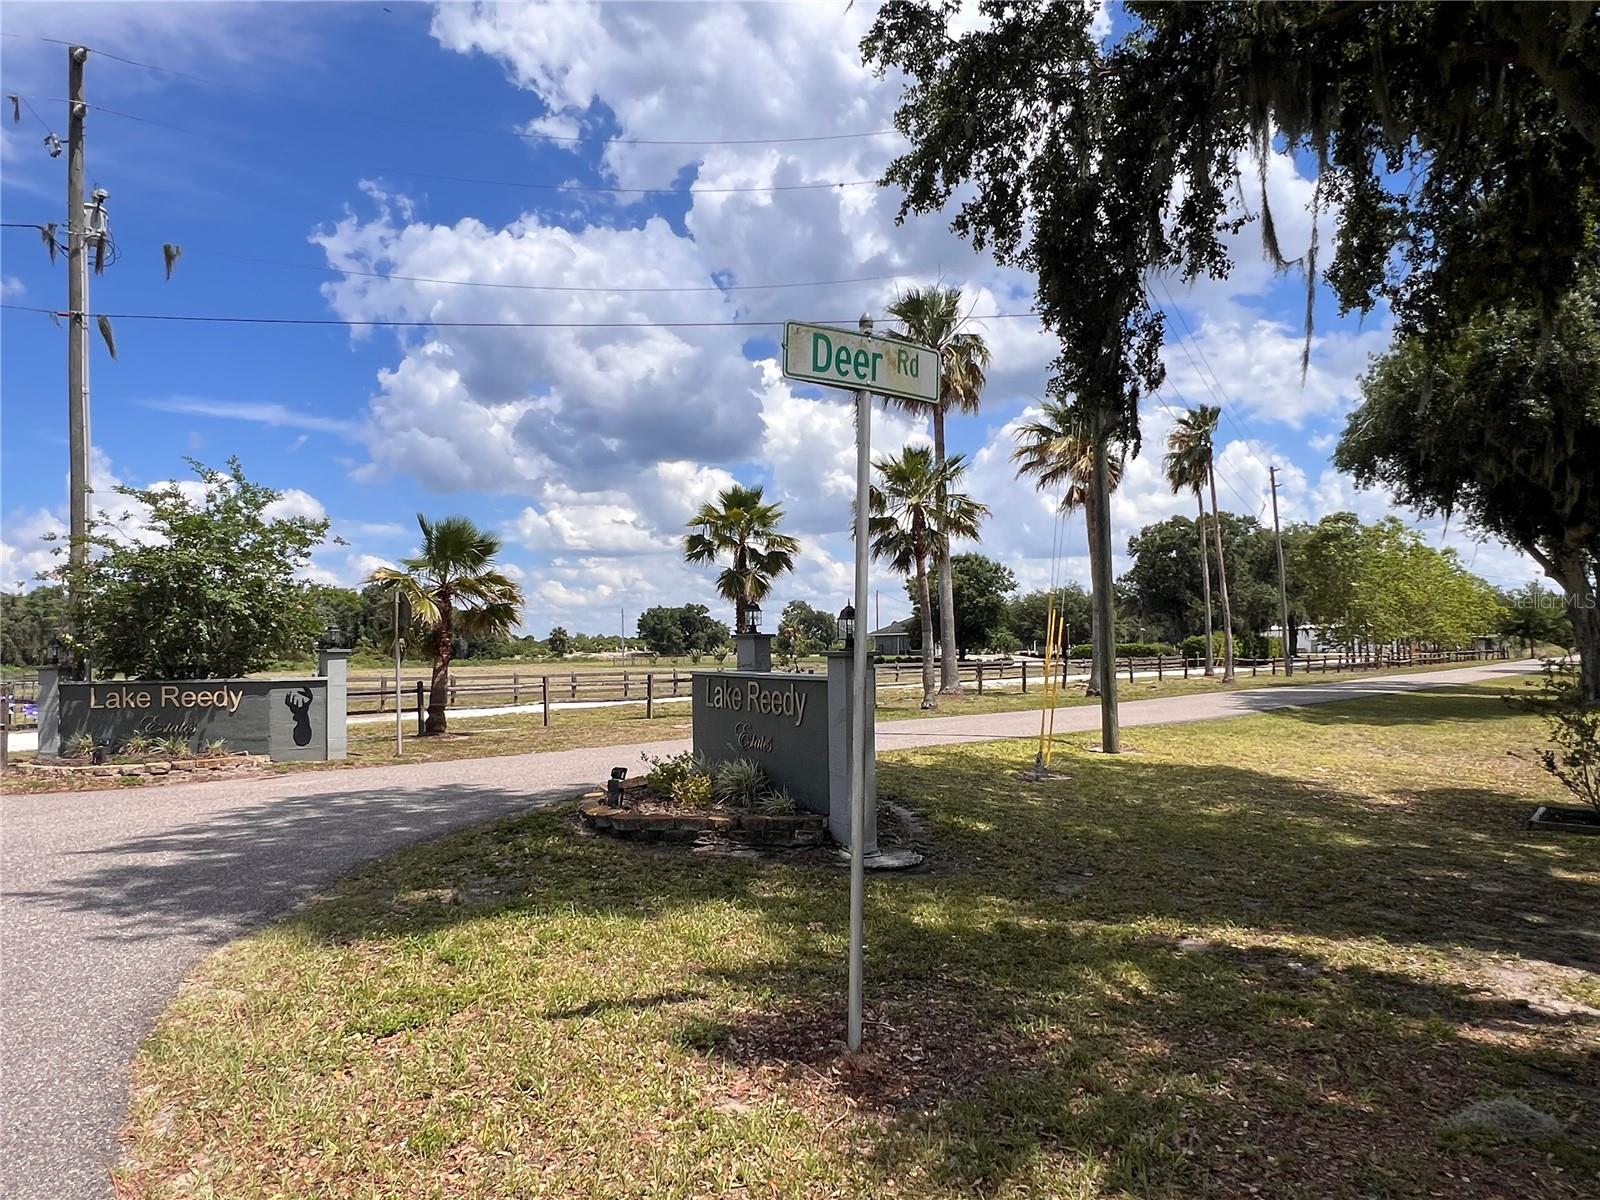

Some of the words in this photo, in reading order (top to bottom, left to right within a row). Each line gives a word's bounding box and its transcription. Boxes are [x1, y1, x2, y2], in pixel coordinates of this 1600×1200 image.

[812, 332, 883, 381] Deer
[897, 349, 919, 377] Rd
[90, 687, 150, 709] Lake
[161, 685, 243, 712] Reedy
[705, 678, 743, 711] Lake
[747, 681, 807, 726] Reedy
